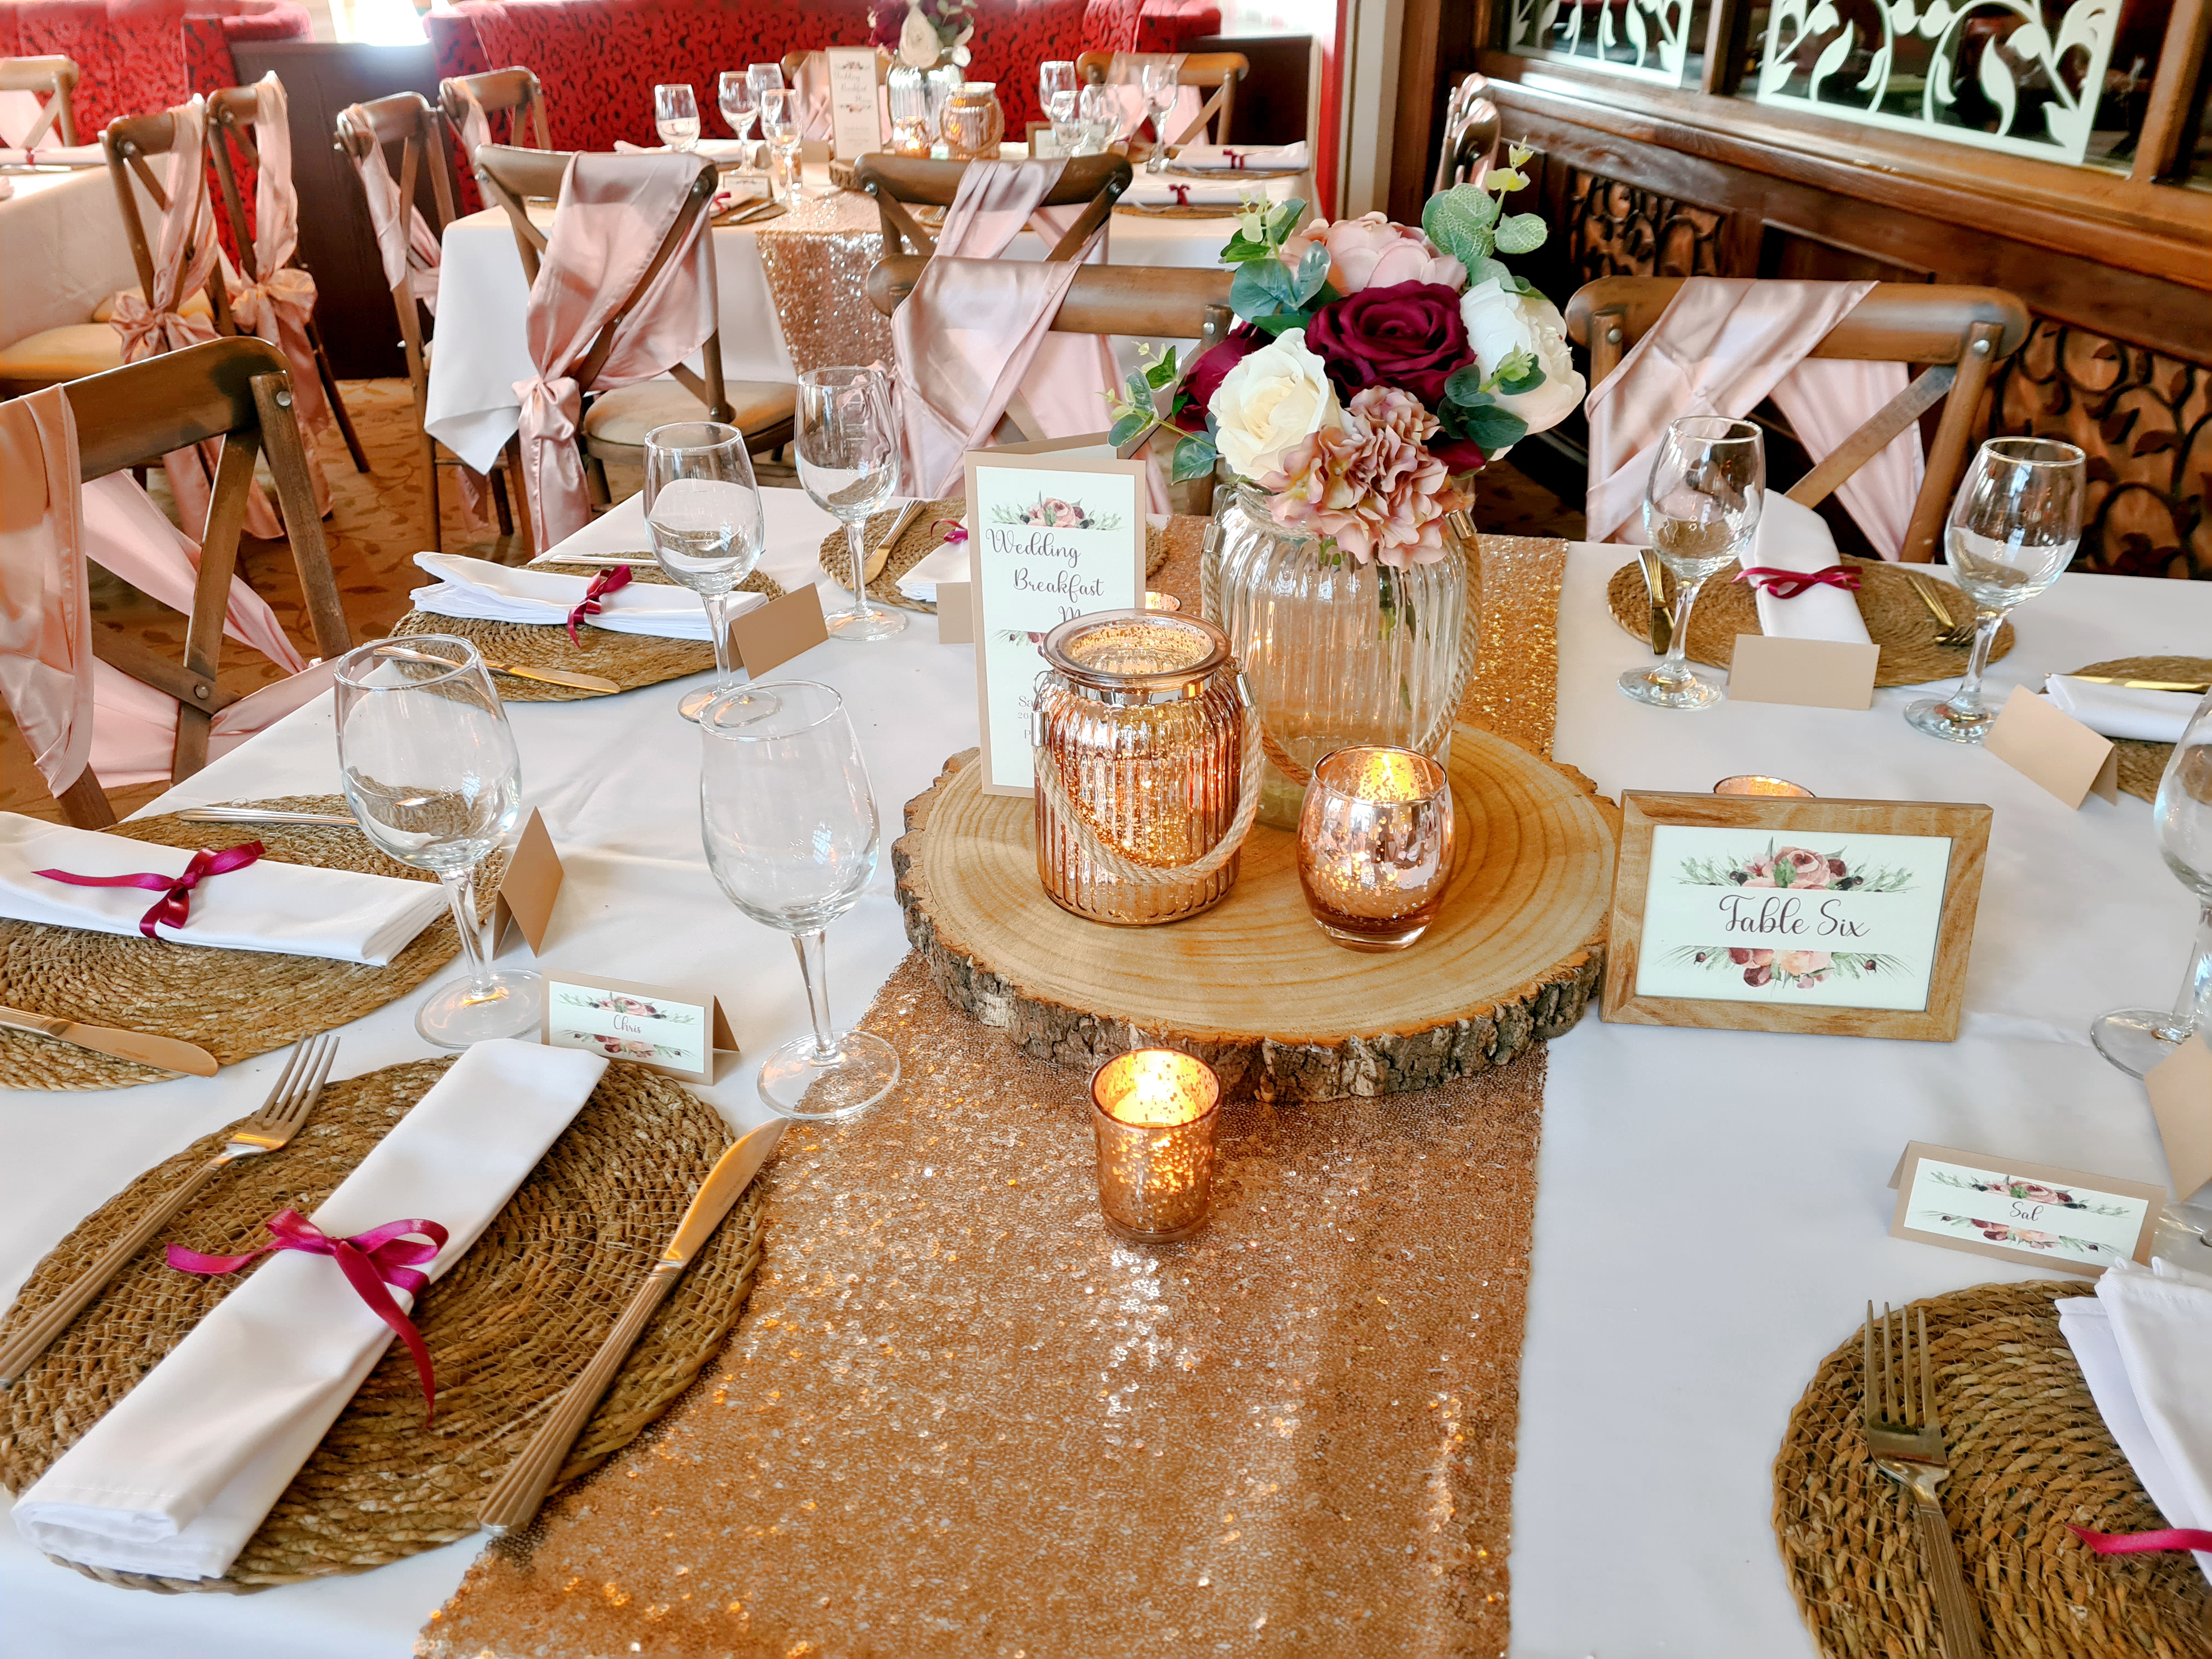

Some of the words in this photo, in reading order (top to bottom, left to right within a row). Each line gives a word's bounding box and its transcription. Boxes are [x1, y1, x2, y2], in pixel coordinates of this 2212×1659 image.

[985, 528, 1081, 568] Wedding
[1013, 567, 1105, 603] Breakfast
[1719, 894, 1810, 934] Table
[1817, 899, 1871, 937] Six
[613, 1014, 641, 1034] Chris
[2010, 1201, 2044, 1221] Sal
